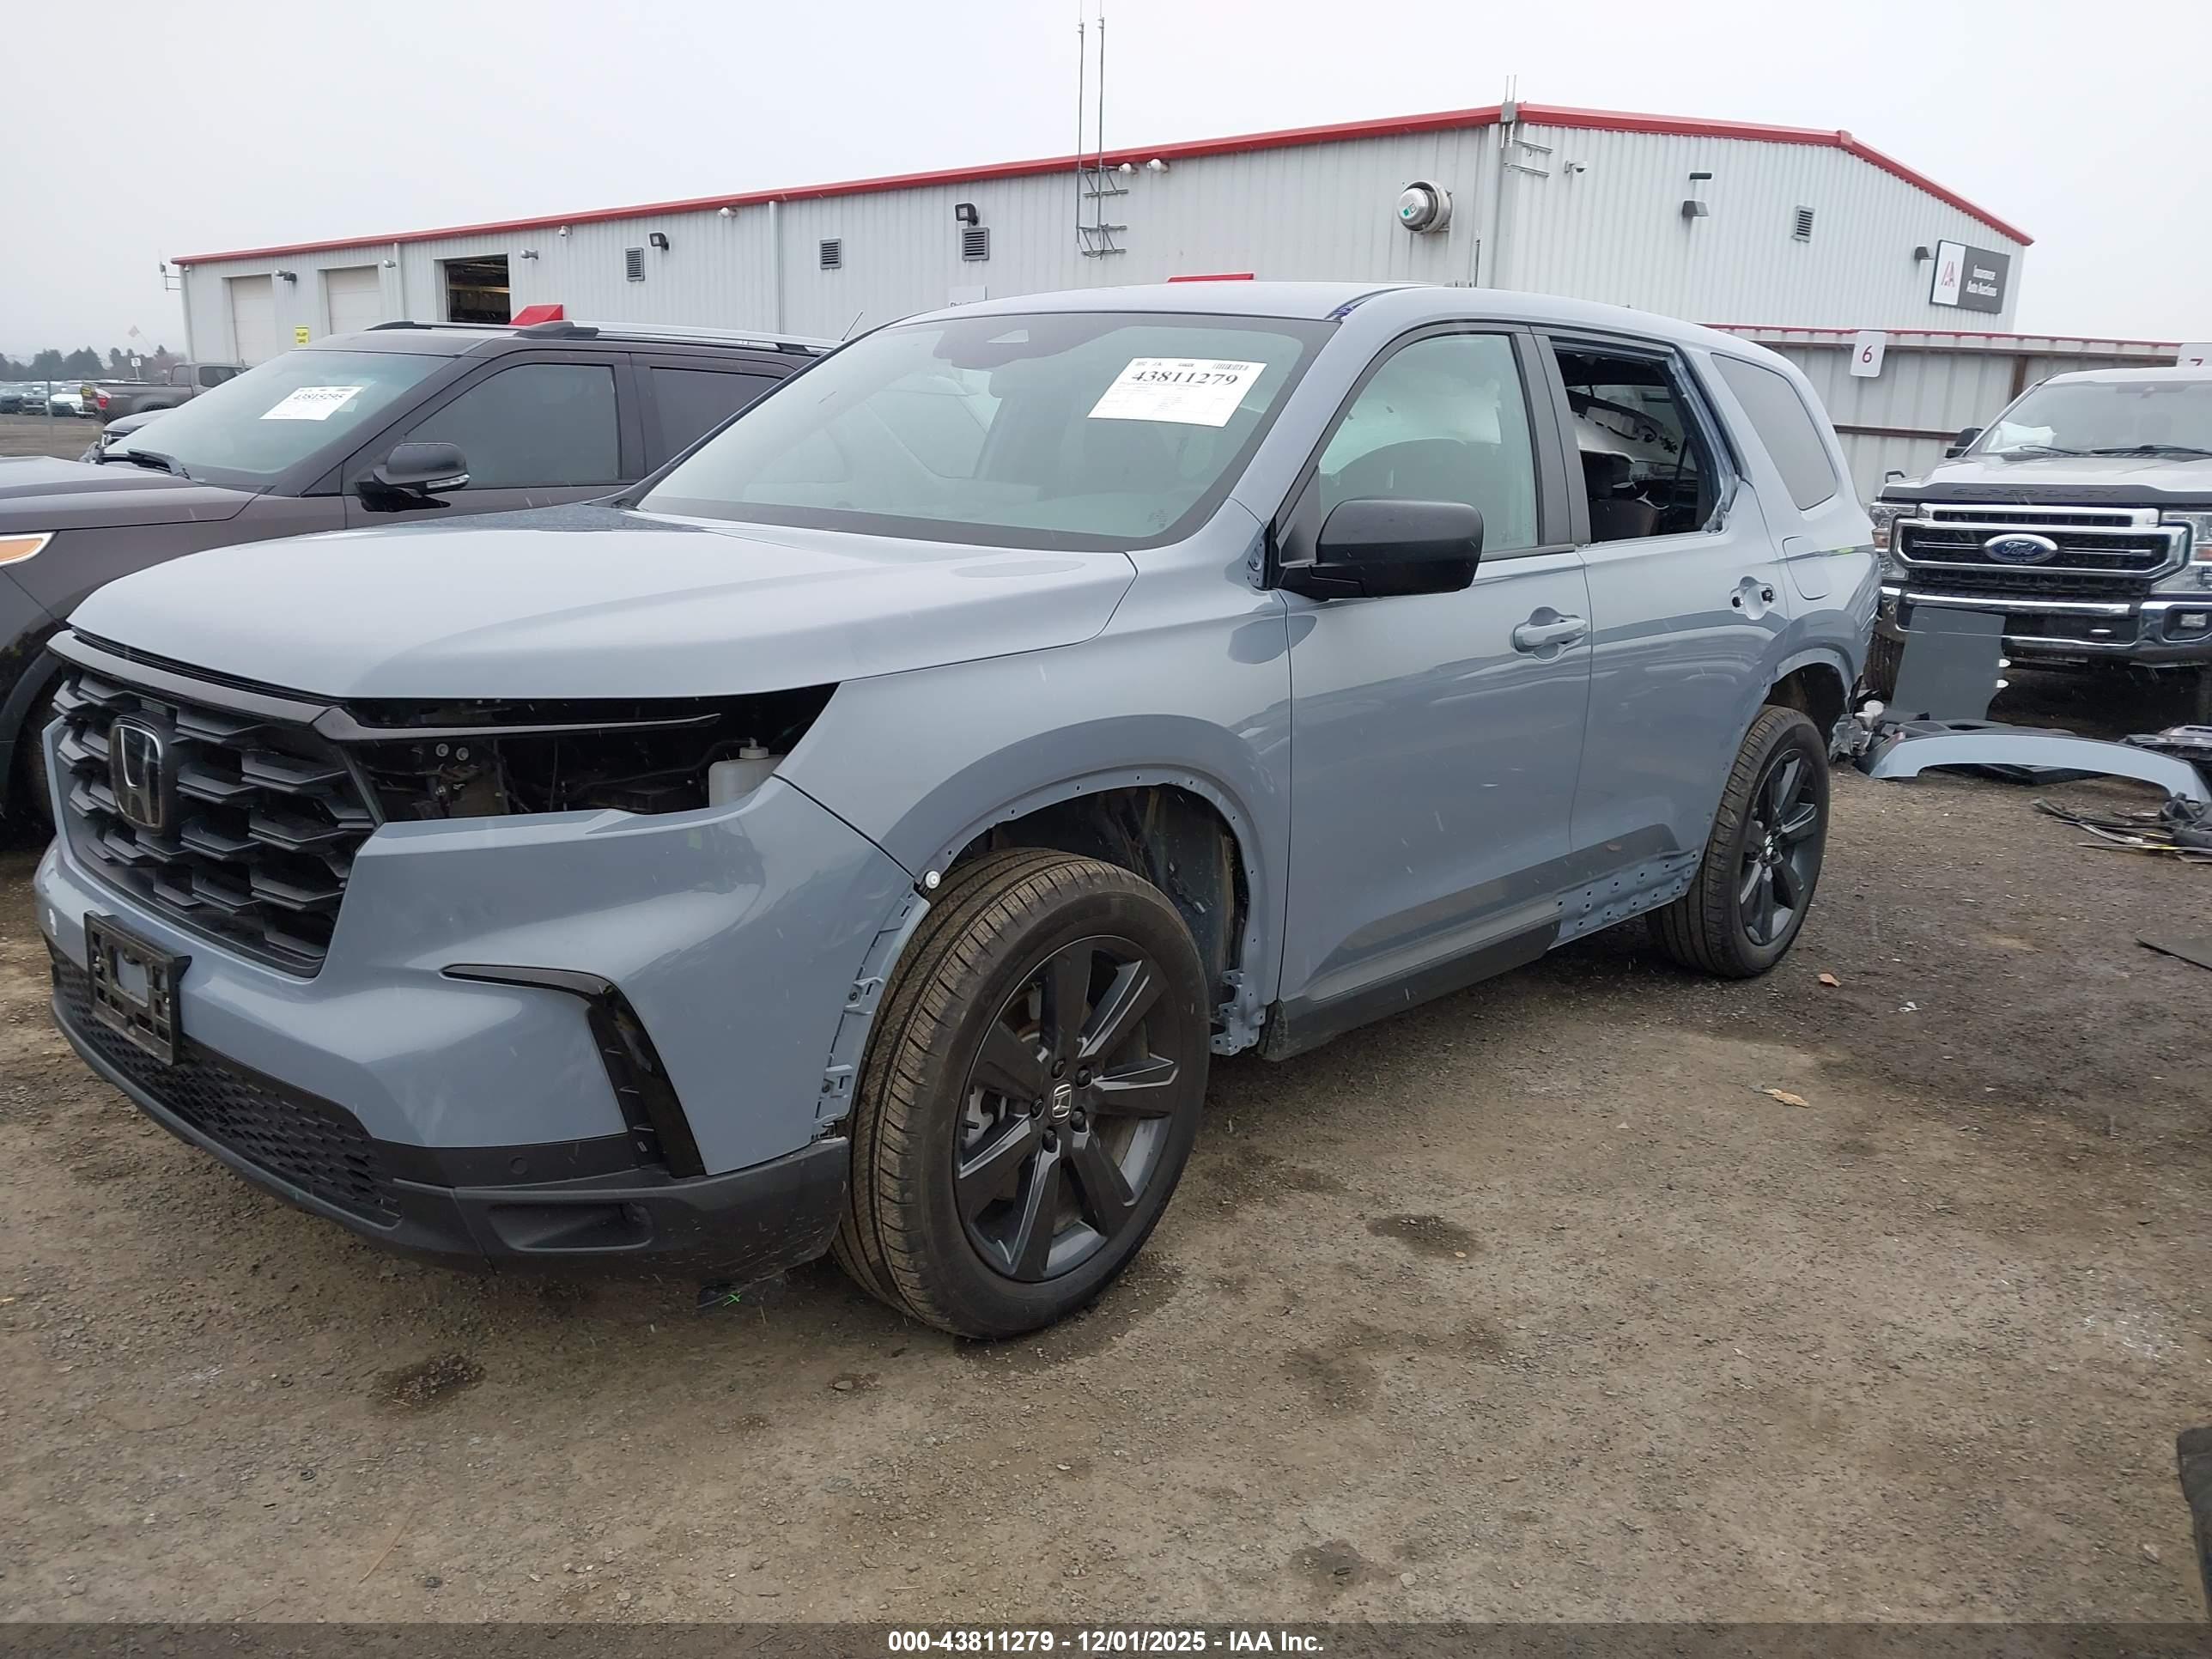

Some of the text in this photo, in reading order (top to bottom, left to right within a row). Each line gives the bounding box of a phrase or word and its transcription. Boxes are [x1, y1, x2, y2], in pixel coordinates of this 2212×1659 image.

[1862, 344, 1873, 363] 6
[1132, 370, 1239, 386] 43811279
[2000, 540, 2038, 556] Ford
